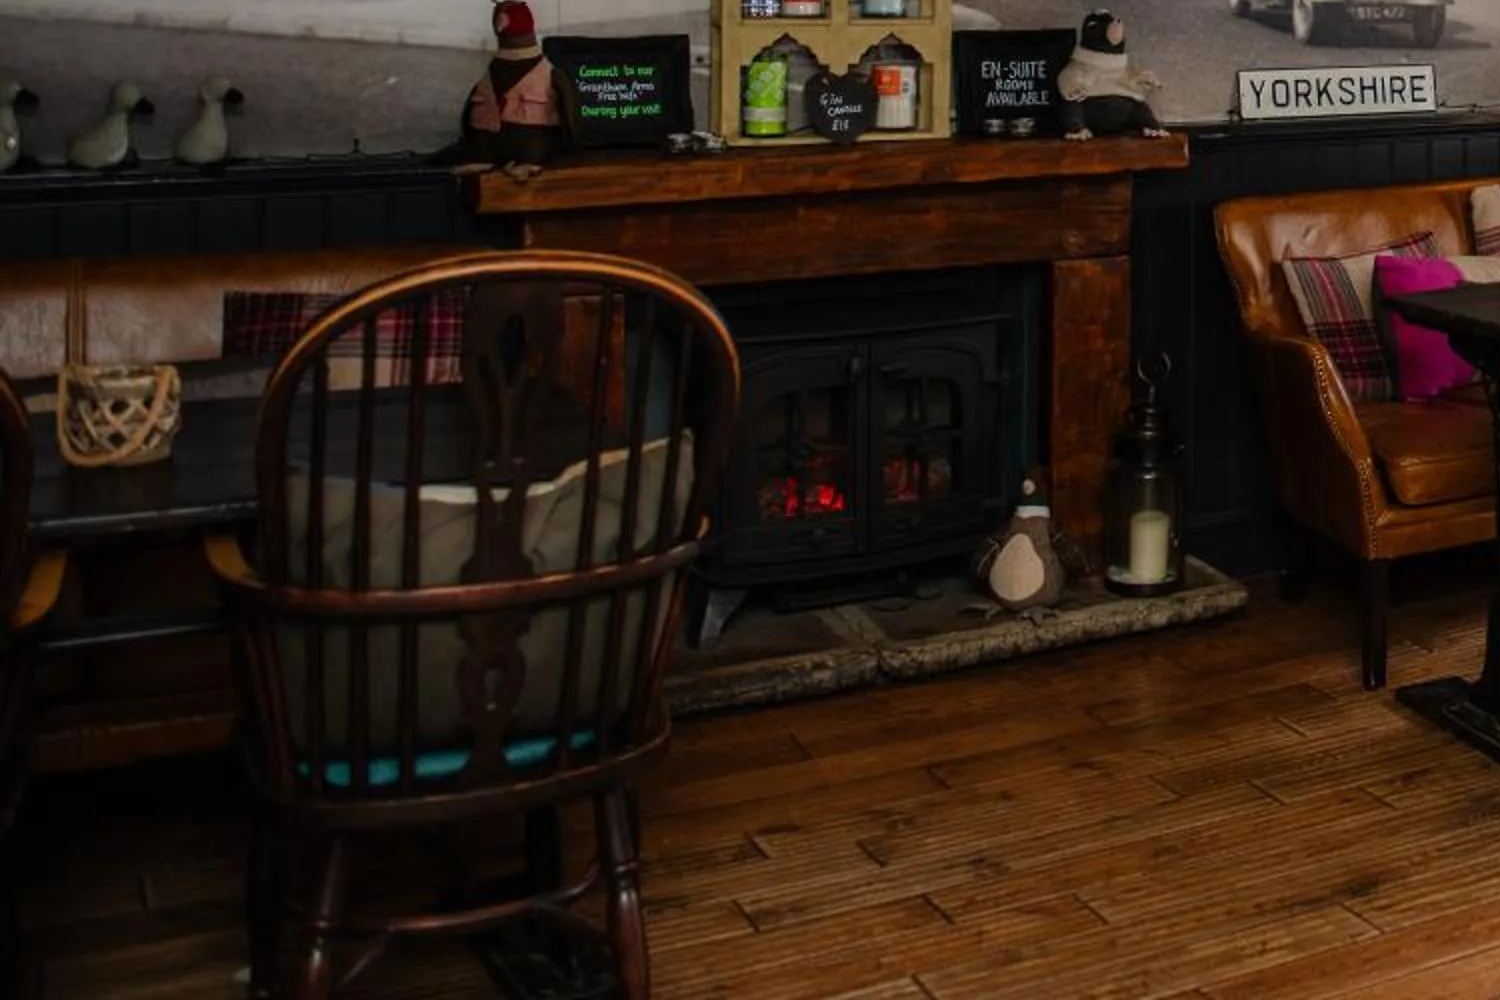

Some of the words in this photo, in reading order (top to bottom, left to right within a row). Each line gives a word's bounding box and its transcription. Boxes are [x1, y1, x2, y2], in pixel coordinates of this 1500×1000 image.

[579, 65, 619, 78] Connect
[981, 60, 1048, 79] EN-SUITE
[985, 90, 1050, 107] AVAILABLE
[1249, 74, 1428, 109] YORKSHIRE
